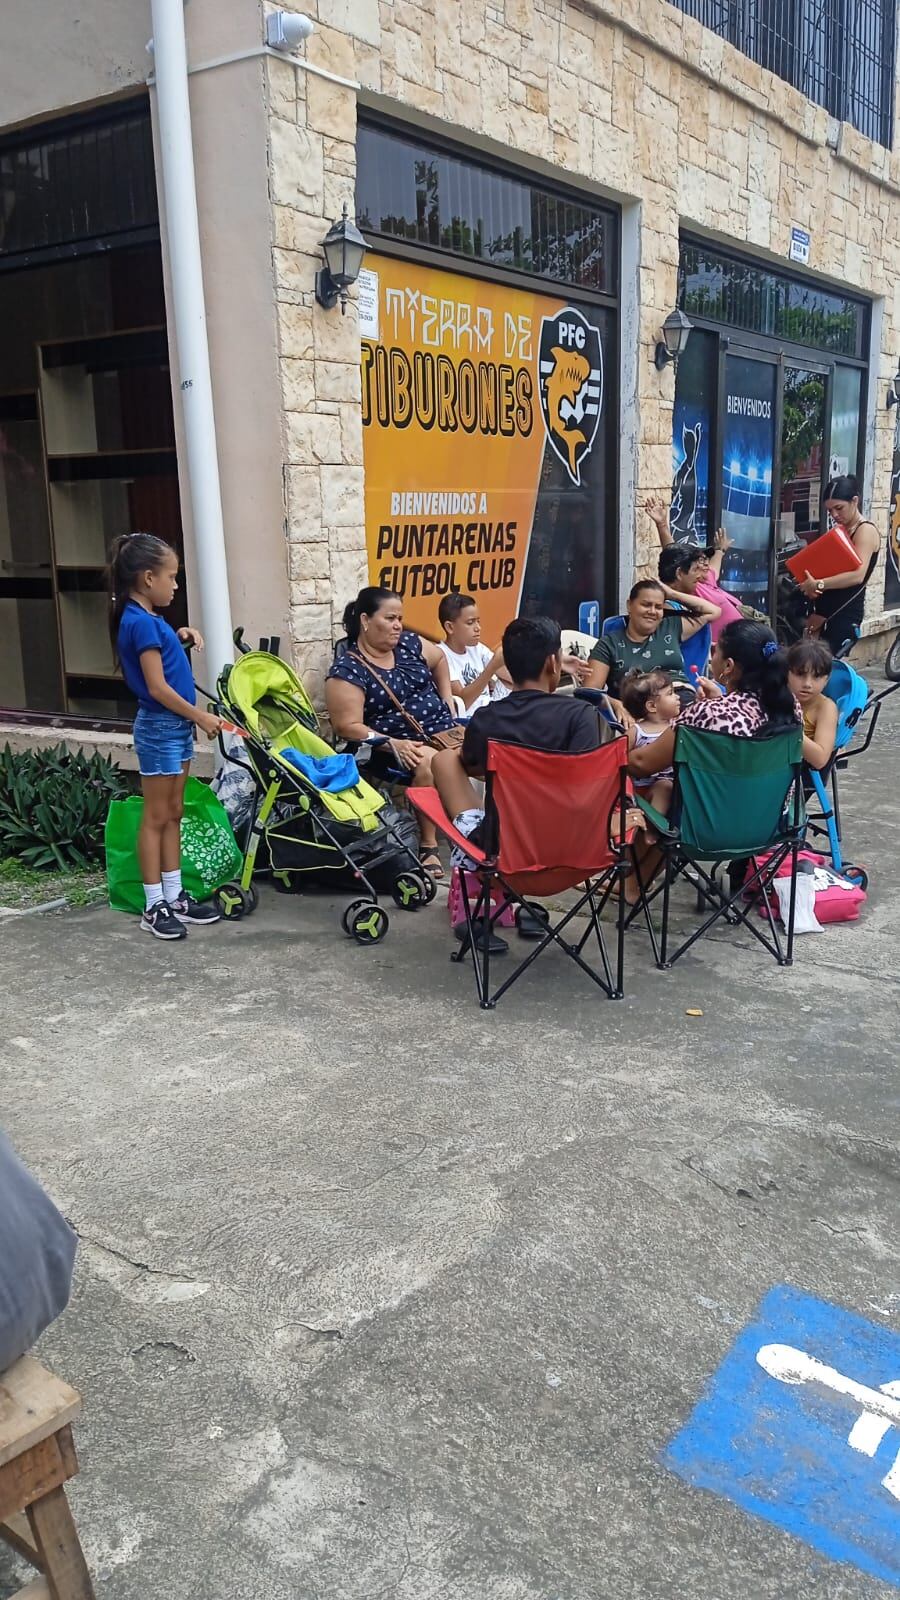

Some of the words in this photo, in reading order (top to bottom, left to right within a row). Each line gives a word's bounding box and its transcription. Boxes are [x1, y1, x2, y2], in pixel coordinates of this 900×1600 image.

[385, 287, 495, 355] TIERRA
[504, 312, 533, 361] DE
[558, 321, 586, 349] PFC
[360, 342, 533, 437] TIBURONES
[727, 395, 771, 419] BIENVENIDOS
[391, 492, 477, 516] BIENVENIDOS
[478, 493, 488, 514] A
[376, 522, 517, 560] PUNTARENAS
[379, 562, 461, 598] FUTBOL
[467, 558, 516, 592] CLUB
